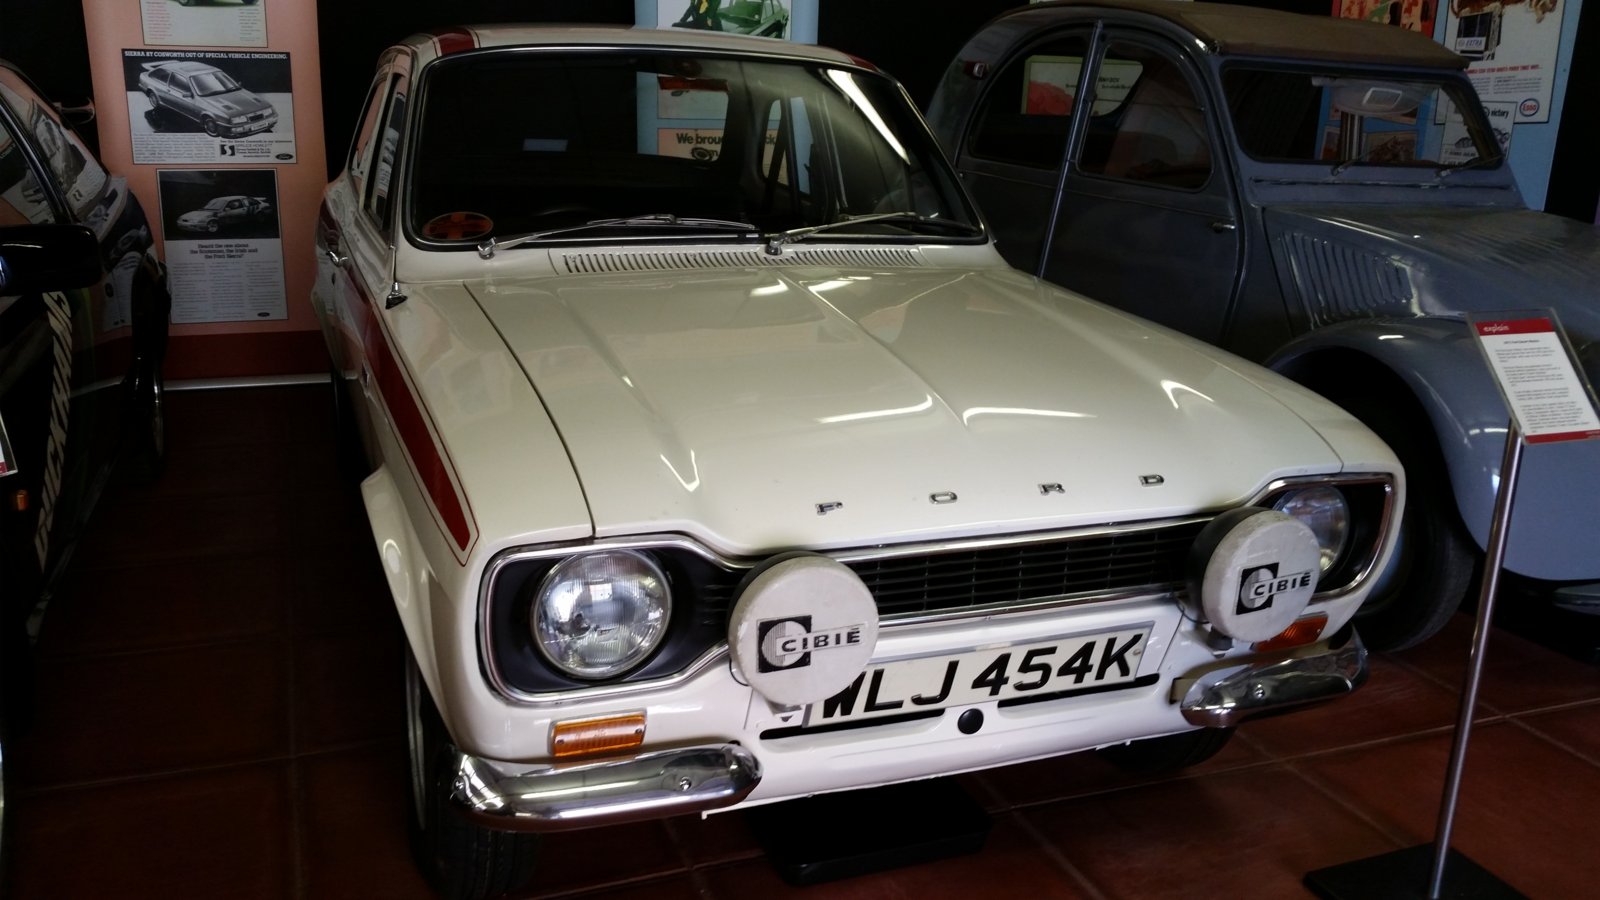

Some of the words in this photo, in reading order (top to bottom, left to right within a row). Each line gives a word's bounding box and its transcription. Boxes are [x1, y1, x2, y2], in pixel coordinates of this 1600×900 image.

[1522, 103, 1537, 112] Esso
[1490, 108, 1509, 119] victory
[676, 133, 694, 144] We
[816, 474, 1165, 515] FORD
[970, 633, 1144, 697] 454K
